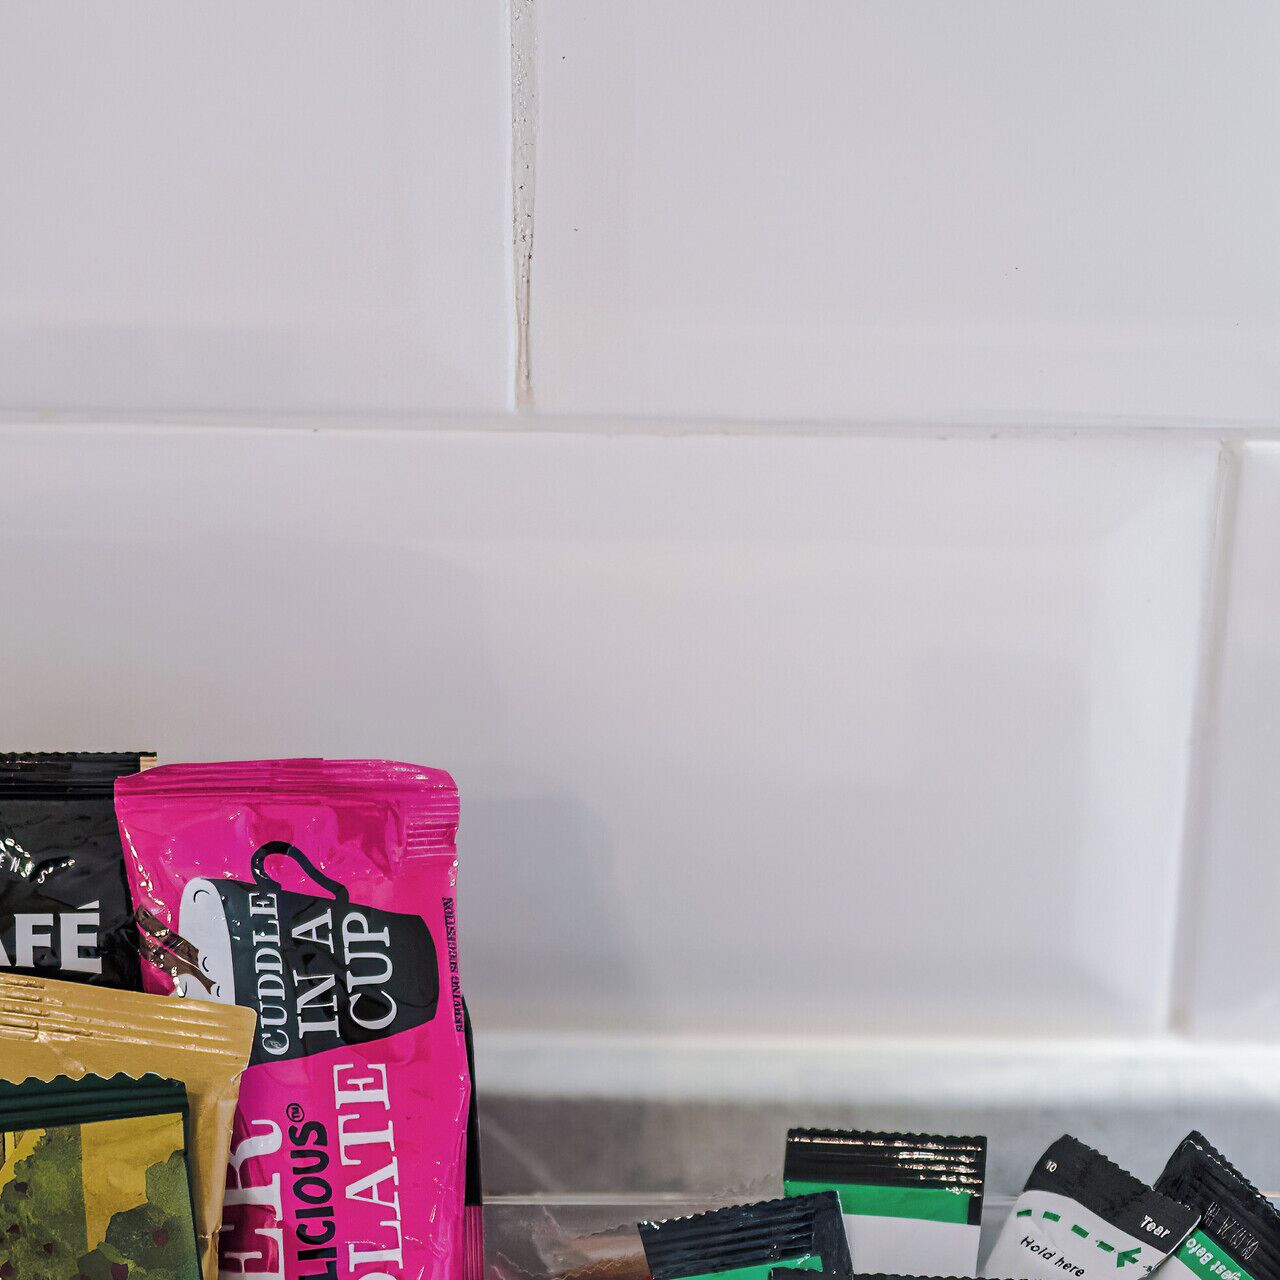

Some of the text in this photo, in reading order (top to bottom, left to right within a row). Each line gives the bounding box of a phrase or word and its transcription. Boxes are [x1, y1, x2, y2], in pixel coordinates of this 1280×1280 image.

[248, 892, 290, 1056] CUDDLE
[291, 908, 341, 1040] IN A
[341, 911, 398, 1030] CUP
[1045, 1159, 1058, 1173] 10
[1138, 1214, 1171, 1239] Tear
[1020, 1235, 1086, 1278] Hold here
[1185, 1237, 1214, 1266] Befo
